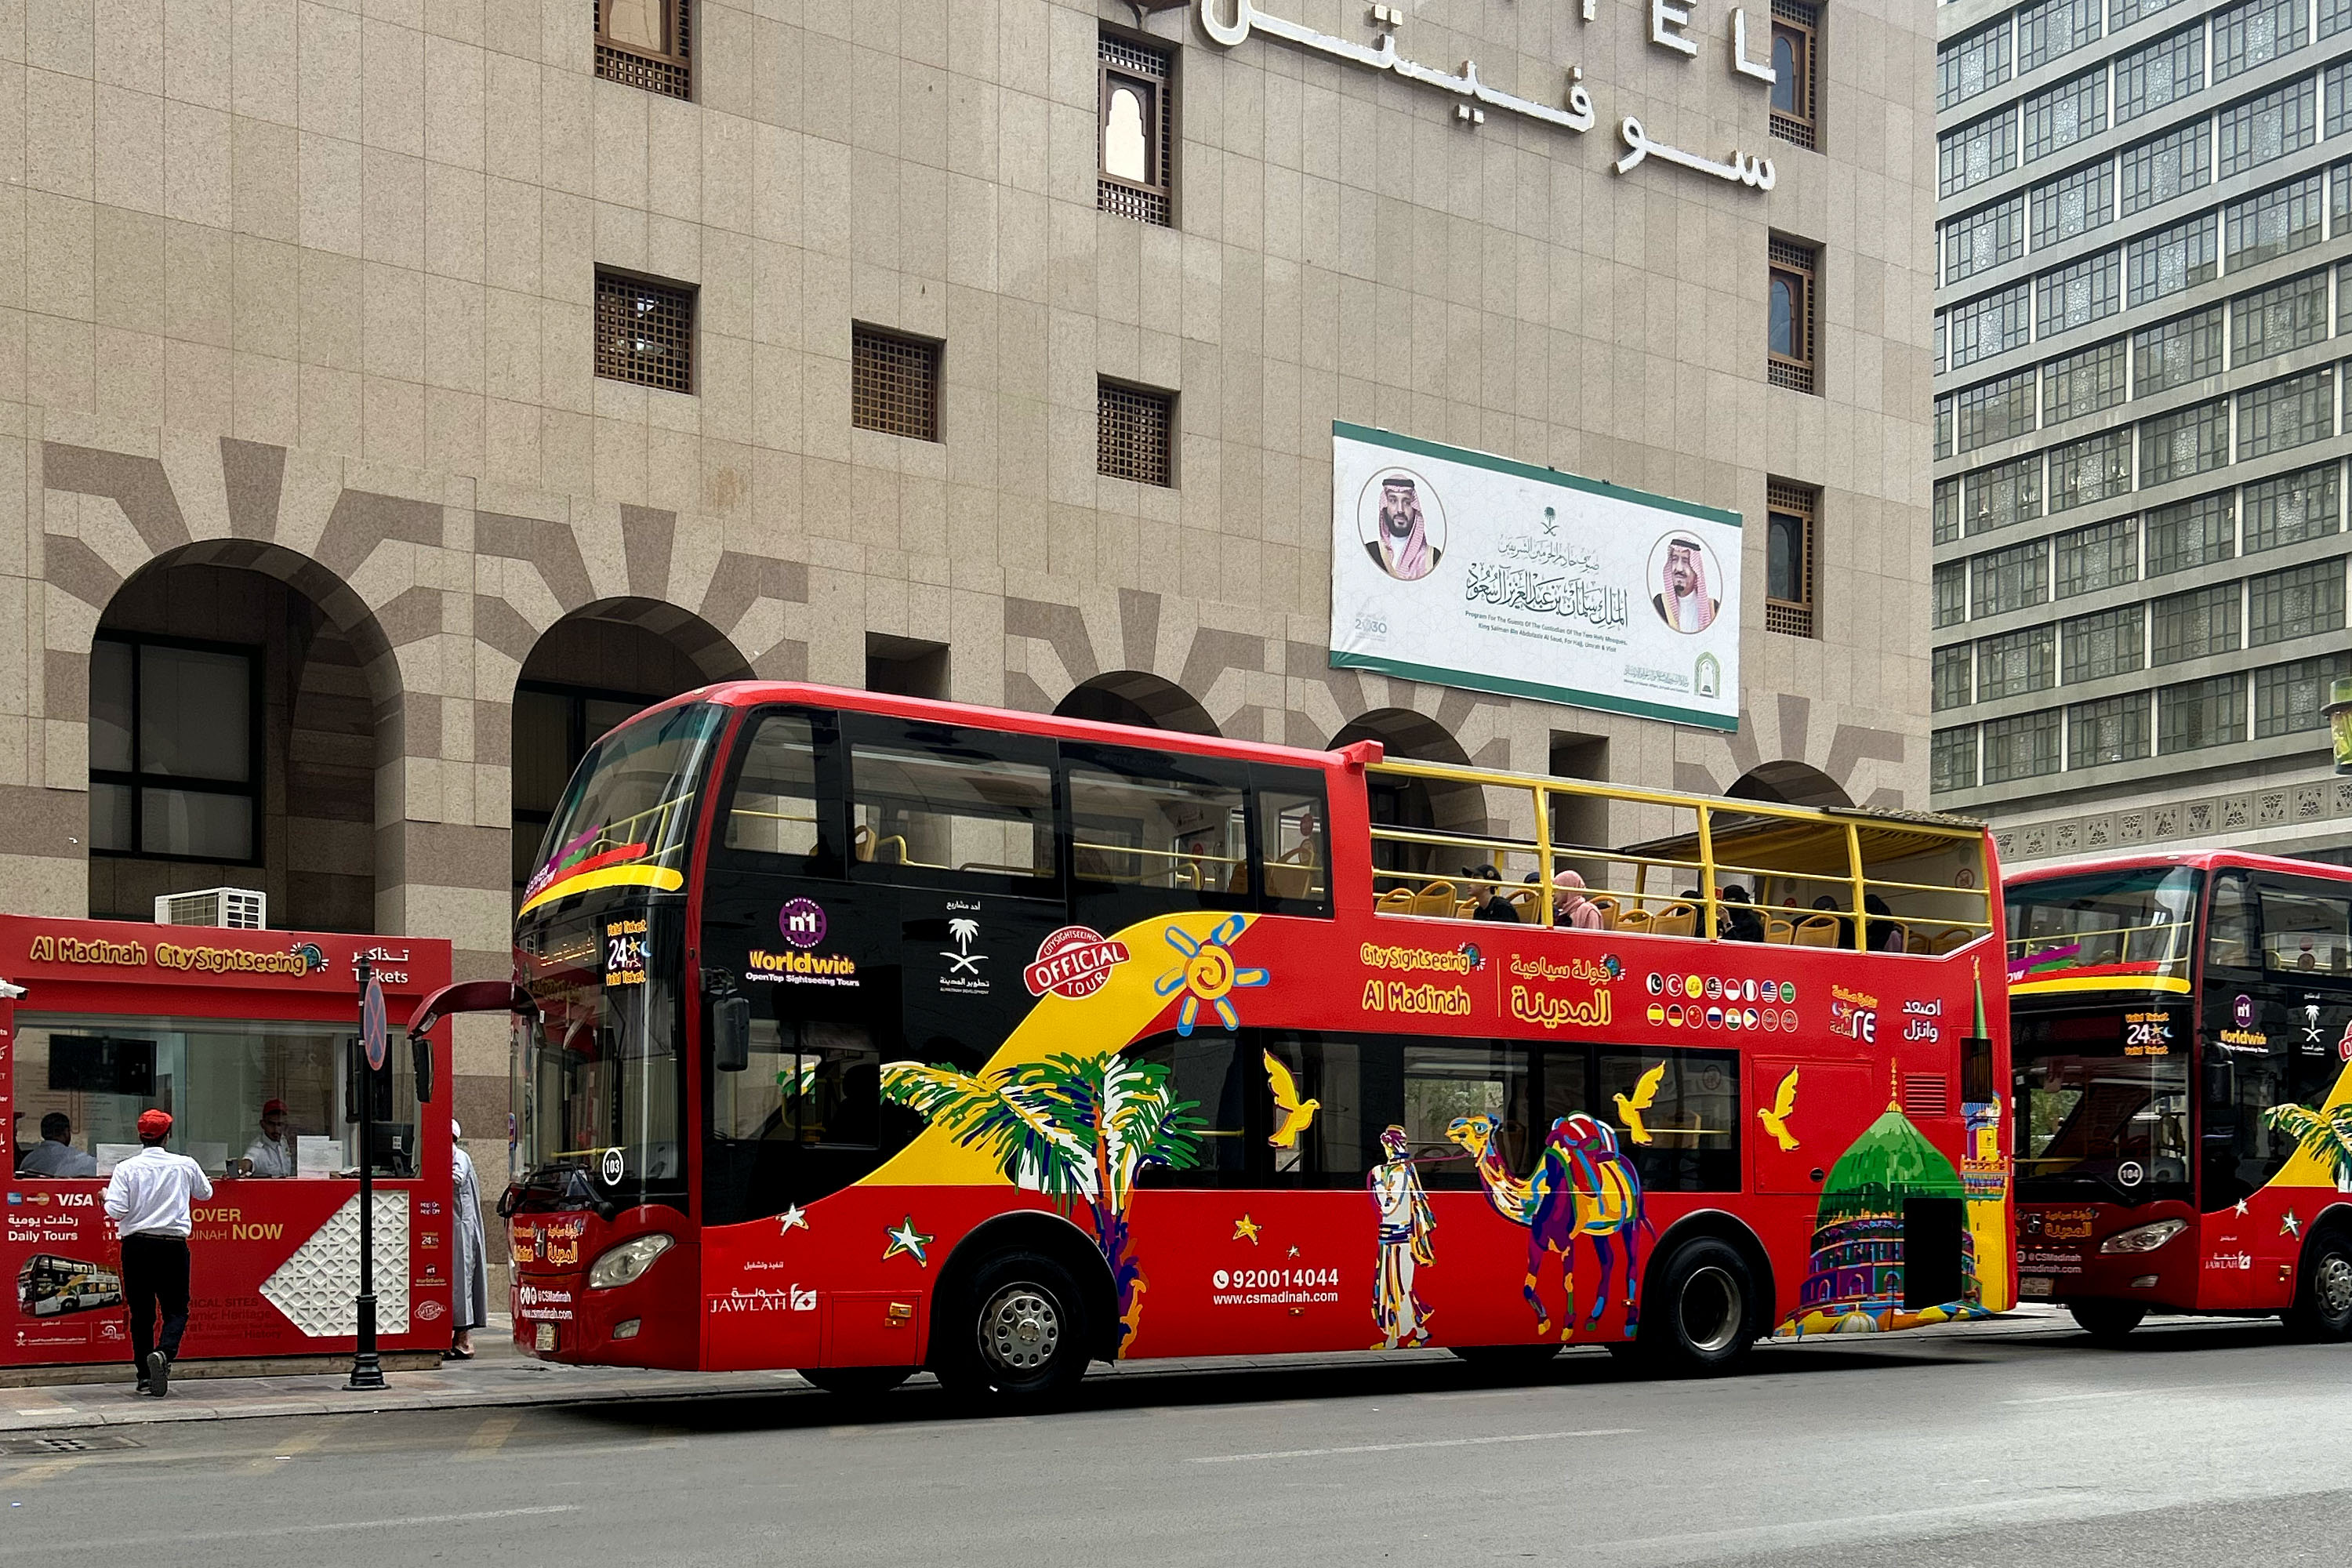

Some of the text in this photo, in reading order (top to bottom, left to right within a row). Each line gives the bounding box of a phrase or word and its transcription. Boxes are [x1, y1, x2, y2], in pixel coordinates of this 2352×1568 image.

[946, 901, 969, 909] مشاريع
[30, 935, 54, 961] Al
[58, 938, 147, 965] Madinah
[1044, 930, 1098, 956] CITYSIGHTSEEING
[608, 938, 627, 970] 24
[750, 950, 855, 975] Worldwide
[1035, 944, 1125, 988] OFFICIAL
[1511, 954, 1612, 985] جولة سياحية
[352, 968, 408, 983] Tkets
[786, 975, 835, 986] Sightseeing
[837, 978, 860, 986] Tours
[940, 976, 989, 987] تطوير المدينة
[1067, 971, 1106, 995] TOUR
[2007, 970, 2025, 983] OW
[1363, 980, 1472, 1015] Al Madinah
[1512, 986, 1612, 1029] المدينة
[1902, 998, 1941, 1015] اصعد
[1904, 1019, 1939, 1043] وانزل
[2127, 1024, 2151, 1045] 24
[2220, 1029, 2267, 1045] Worldwide
[605, 1160, 620, 1174] 103
[2122, 1169, 2140, 1178] 104
[55, 1193, 94, 1207] VISA
[8, 1213, 78, 1227] رحلات يومية
[191, 1208, 241, 1222] OVER
[8, 1230, 78, 1243] Daily Tours
[187, 1223, 284, 1240] DINAH NOW
[2045, 1221, 2092, 1239] المدينة
[1232, 1269, 1339, 1288] 920014044
[710, 1298, 786, 1312] JAWLAH
[1213, 1290, 1338, 1305] www.csmadinah.com
